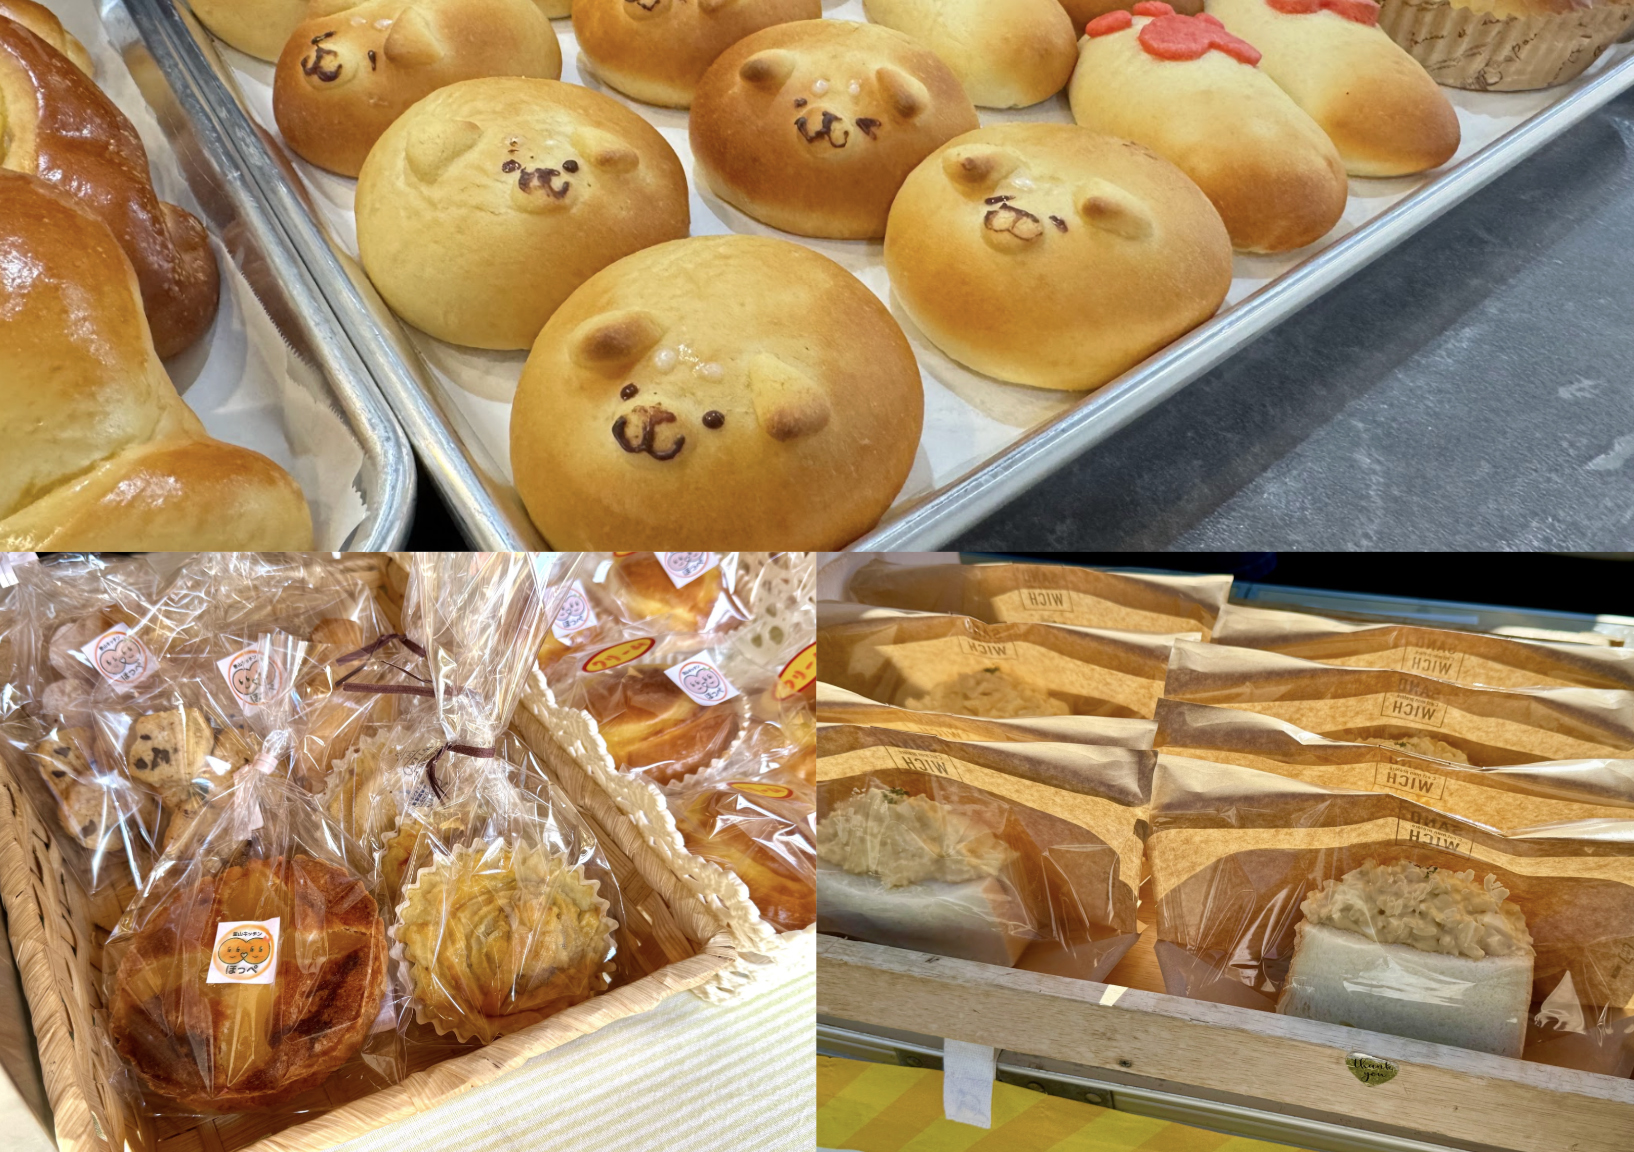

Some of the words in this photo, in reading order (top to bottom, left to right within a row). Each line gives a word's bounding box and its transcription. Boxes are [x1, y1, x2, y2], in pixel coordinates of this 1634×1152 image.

[783, 652, 817, 690] クリー
[225, 964, 259, 975] ほっぺ
[1360, 1071, 1387, 1083] you
